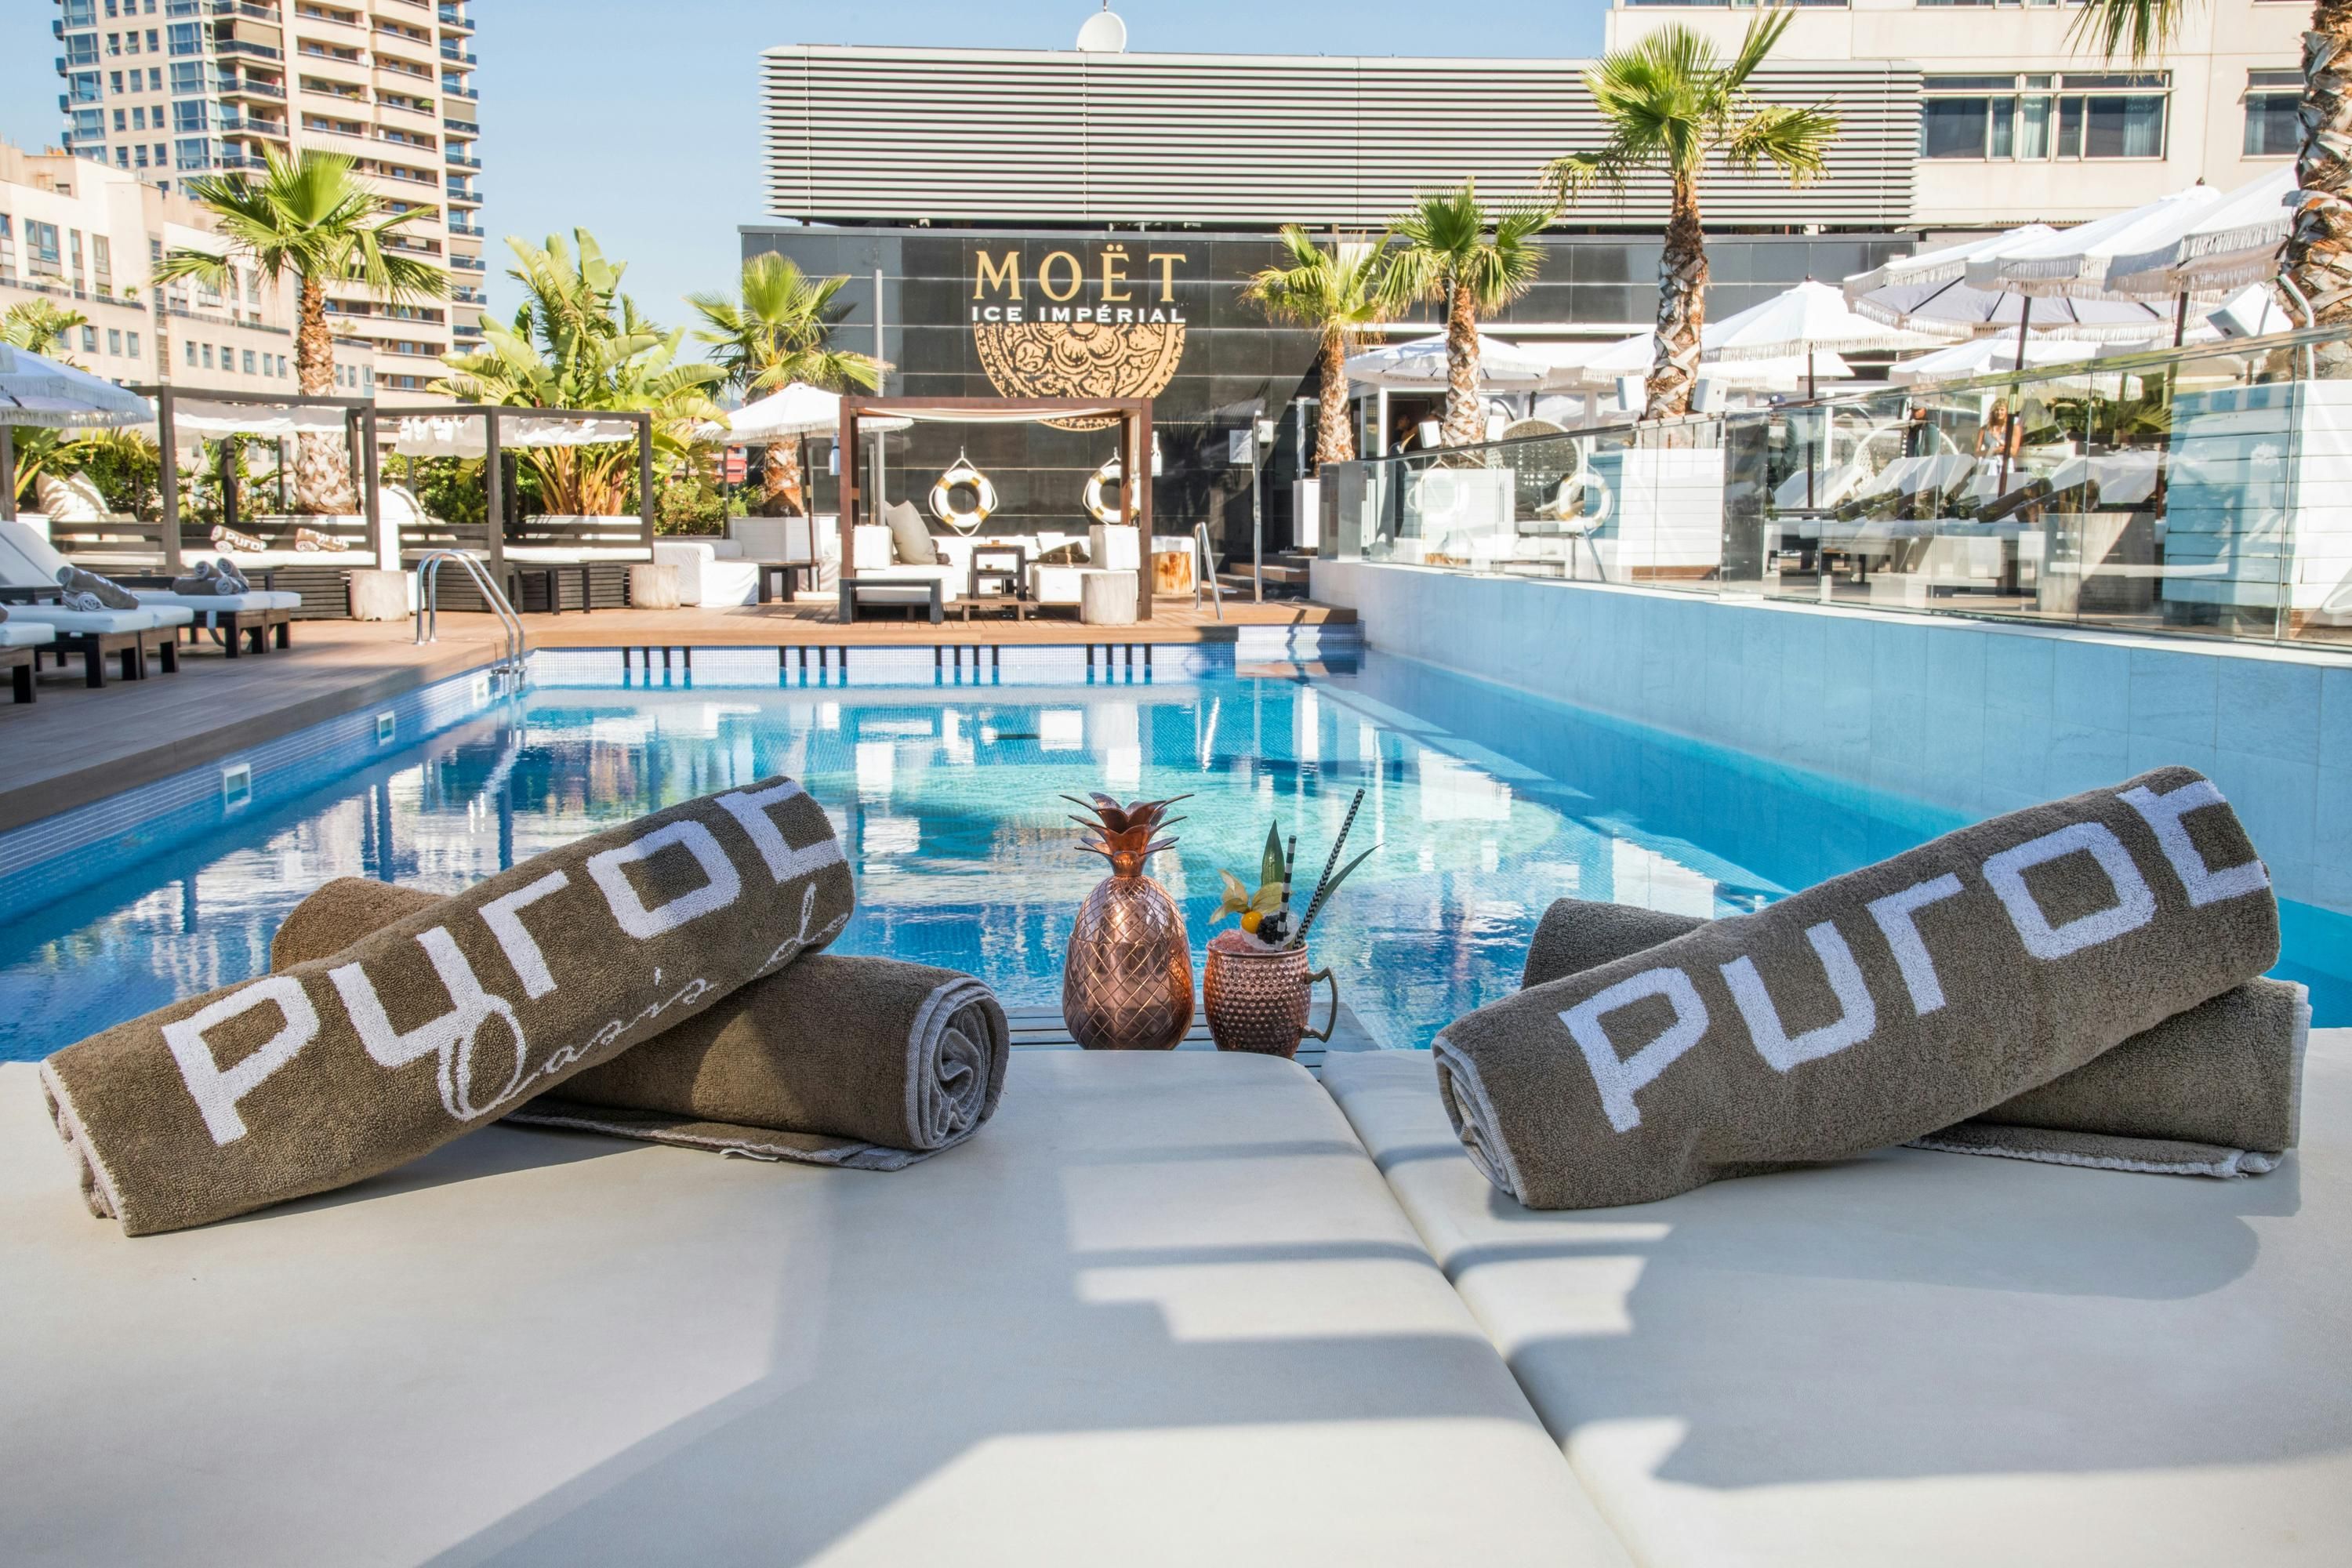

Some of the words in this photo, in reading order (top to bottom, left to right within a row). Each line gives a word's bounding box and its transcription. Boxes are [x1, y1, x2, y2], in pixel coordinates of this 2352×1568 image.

[972, 244, 1186, 302] MOËT
[972, 306, 1022, 322] ICE
[1039, 303, 1186, 323] IMPÉRIAL
